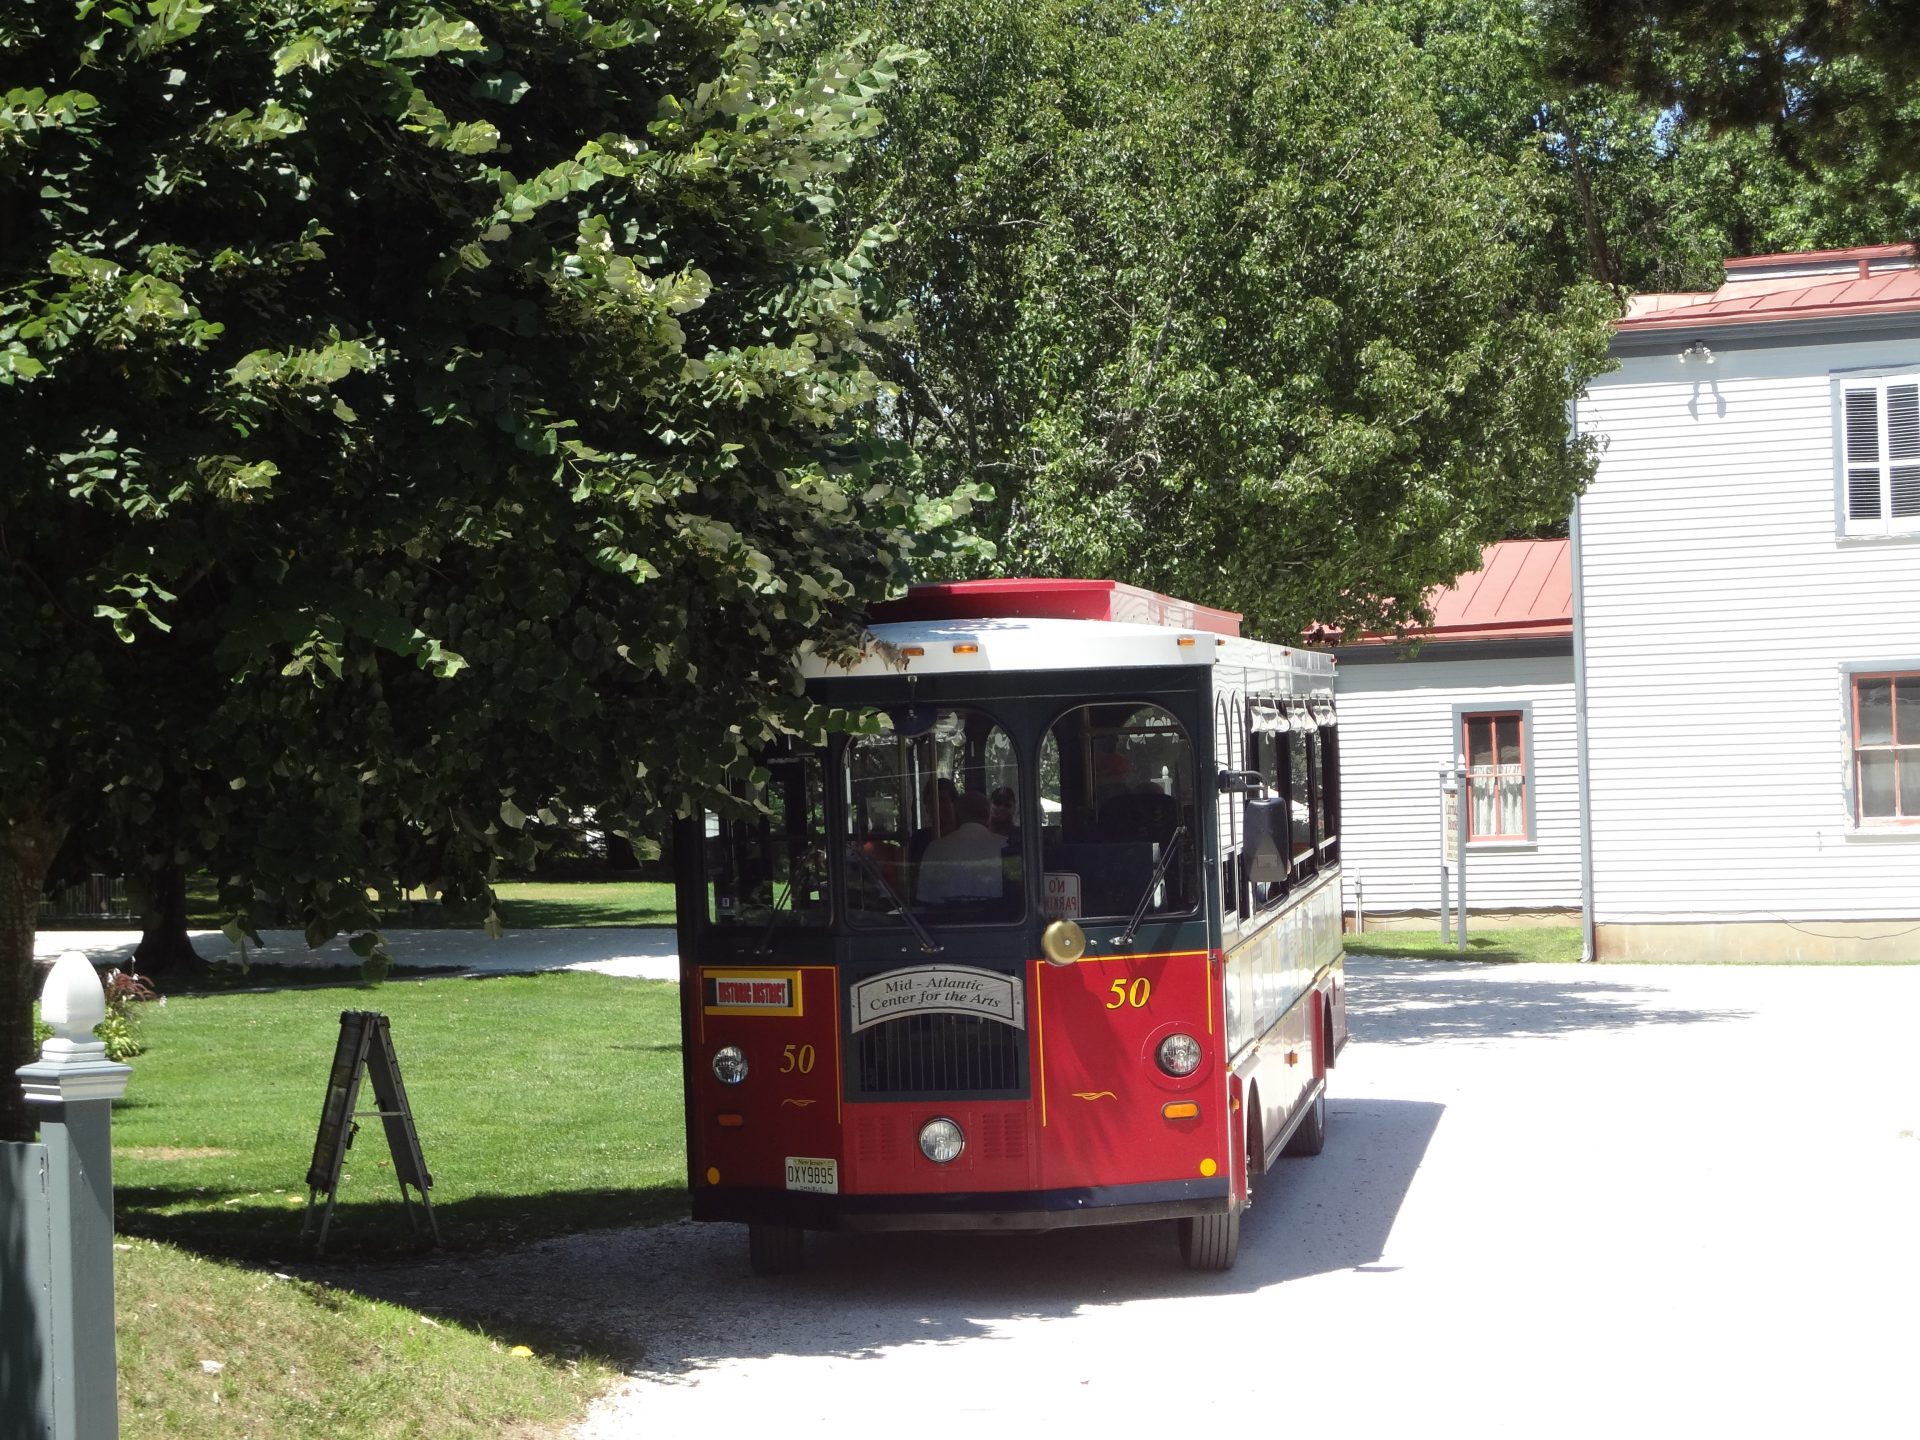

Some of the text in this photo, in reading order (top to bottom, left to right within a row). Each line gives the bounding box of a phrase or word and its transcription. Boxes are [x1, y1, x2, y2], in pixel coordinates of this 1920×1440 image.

[885, 979, 912, 994] Mid
[927, 977, 983, 991] Atlantic
[1106, 977, 1151, 1009] 50
[870, 990, 1001, 1011] Center for the Arts
[780, 1044, 816, 1074] 50
